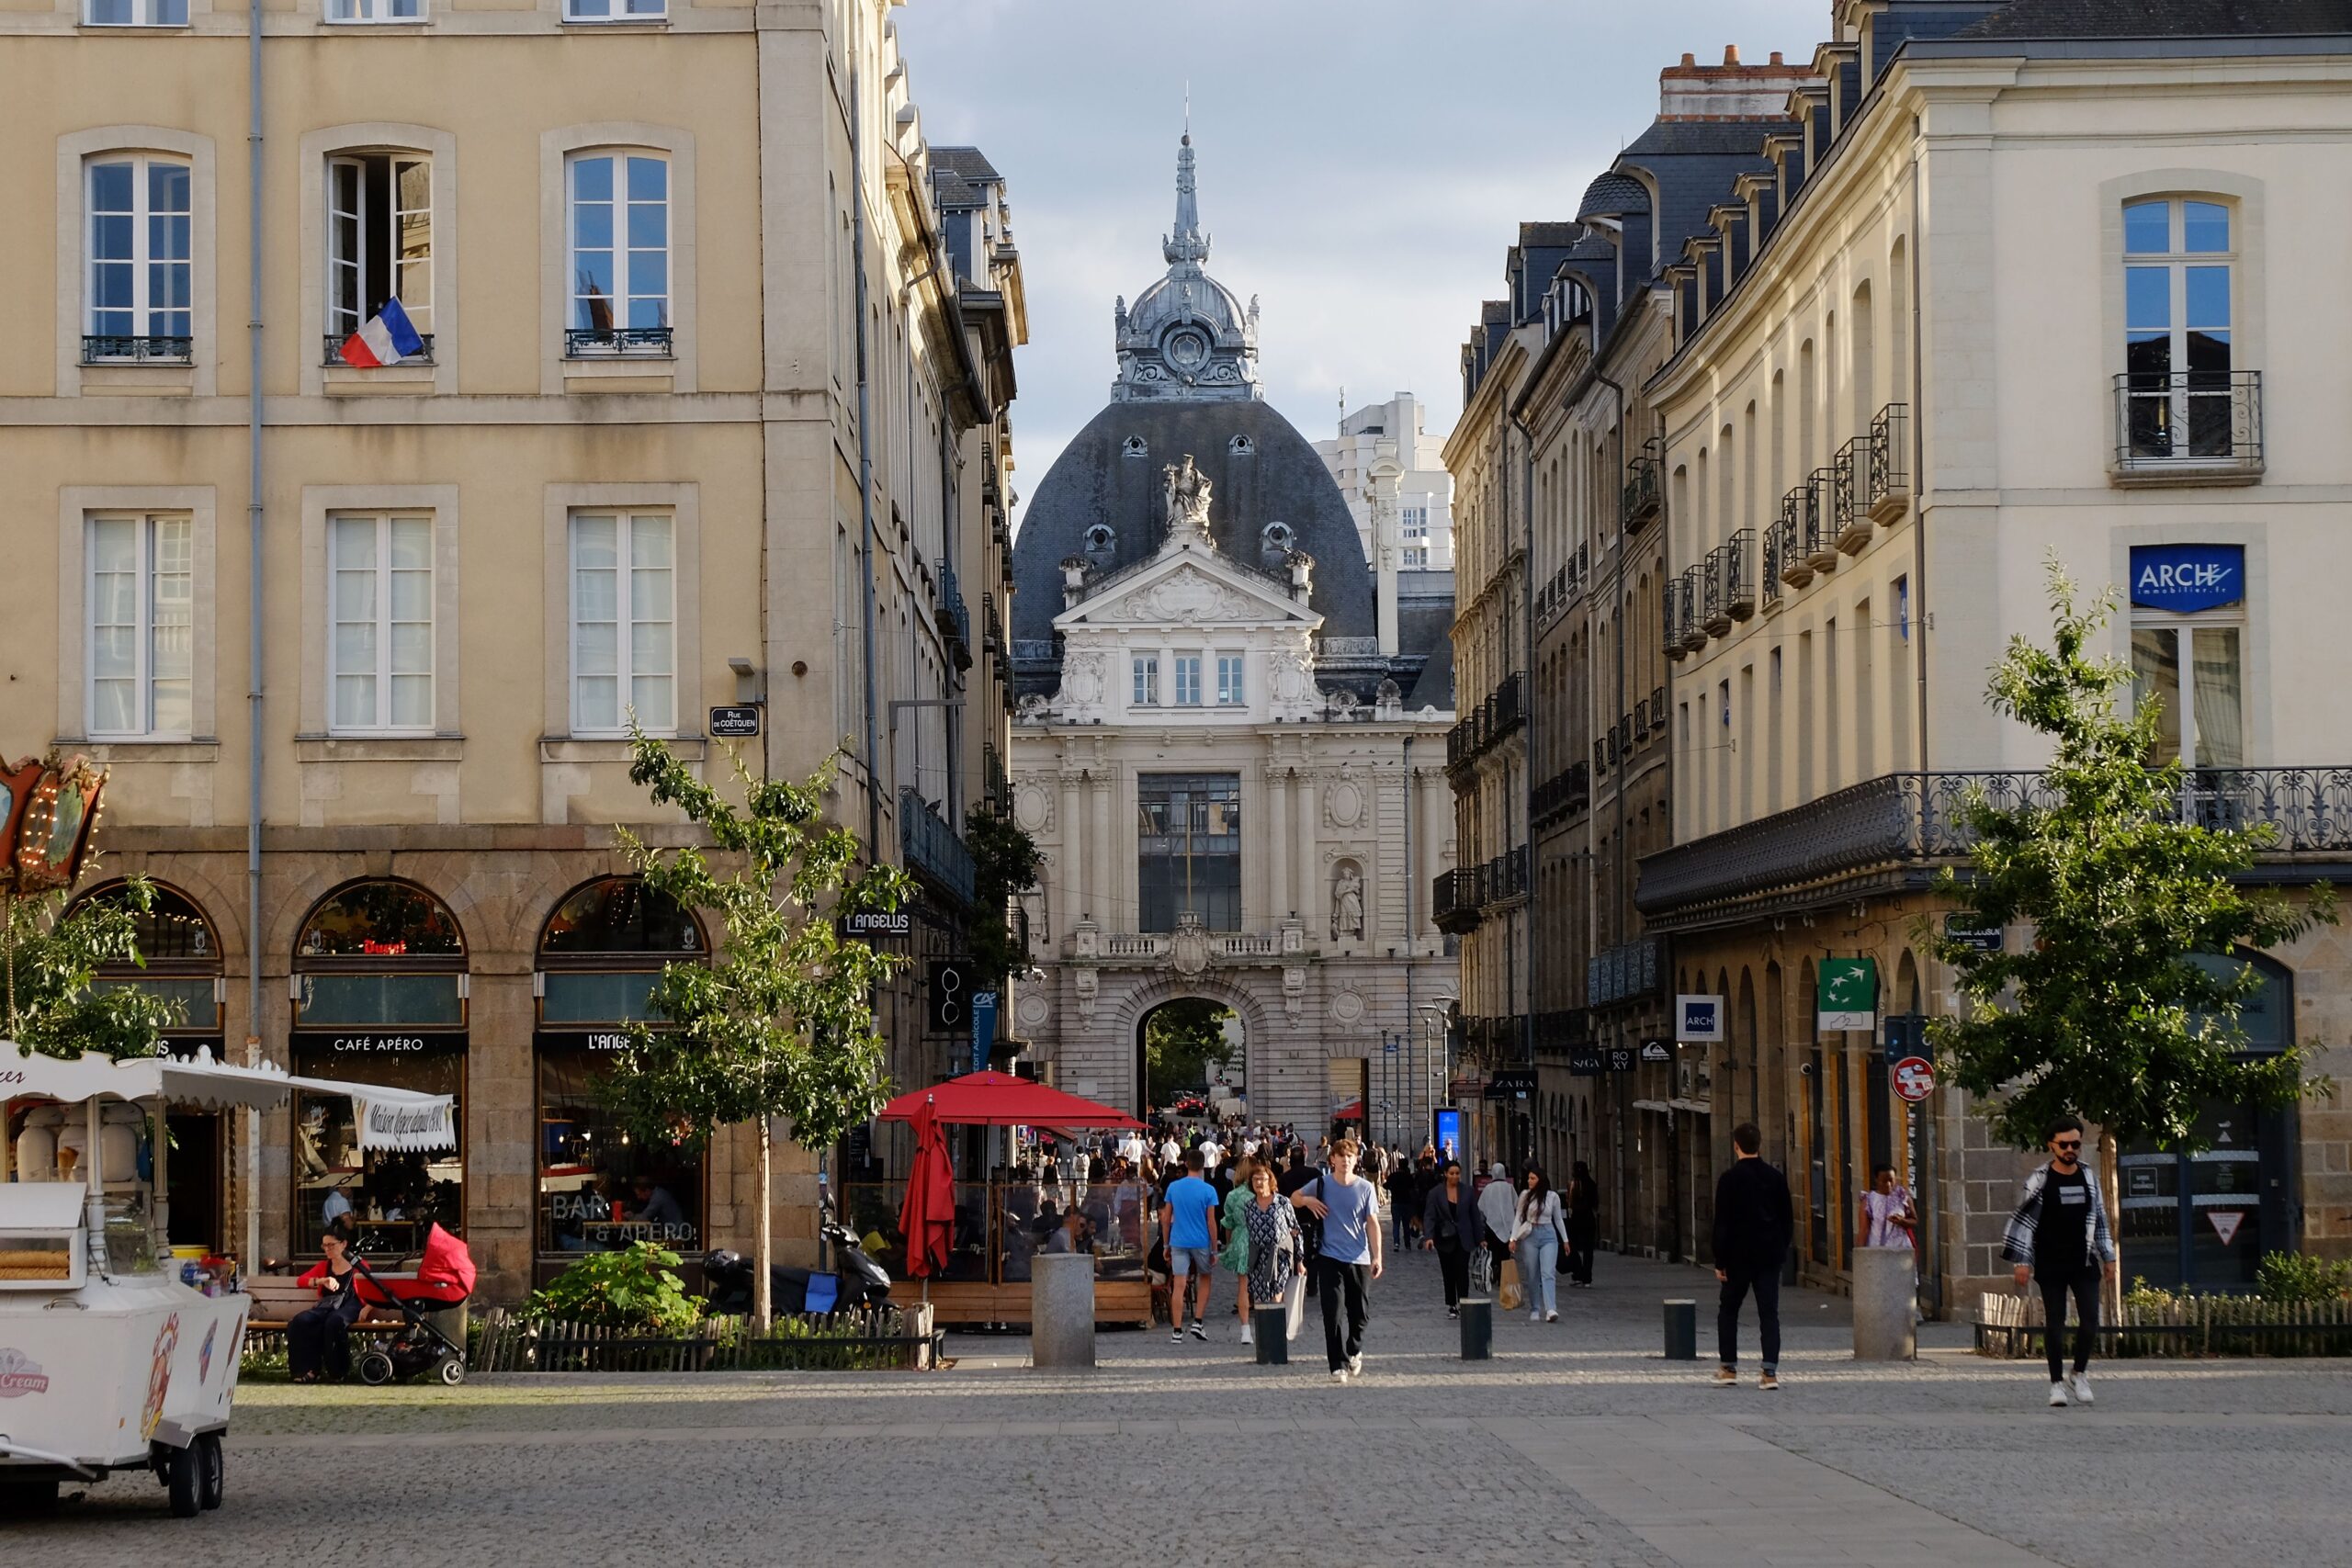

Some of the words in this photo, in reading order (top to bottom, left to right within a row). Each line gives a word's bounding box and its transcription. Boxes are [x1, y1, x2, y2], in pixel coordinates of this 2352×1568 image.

[334, 1036, 370, 1051] CAFÉ
[376, 1036, 424, 1051] APÉRO
[553, 1195, 605, 1220] BAR
[596, 1224, 609, 1242] &
[619, 1217, 692, 1241] APÉRO
